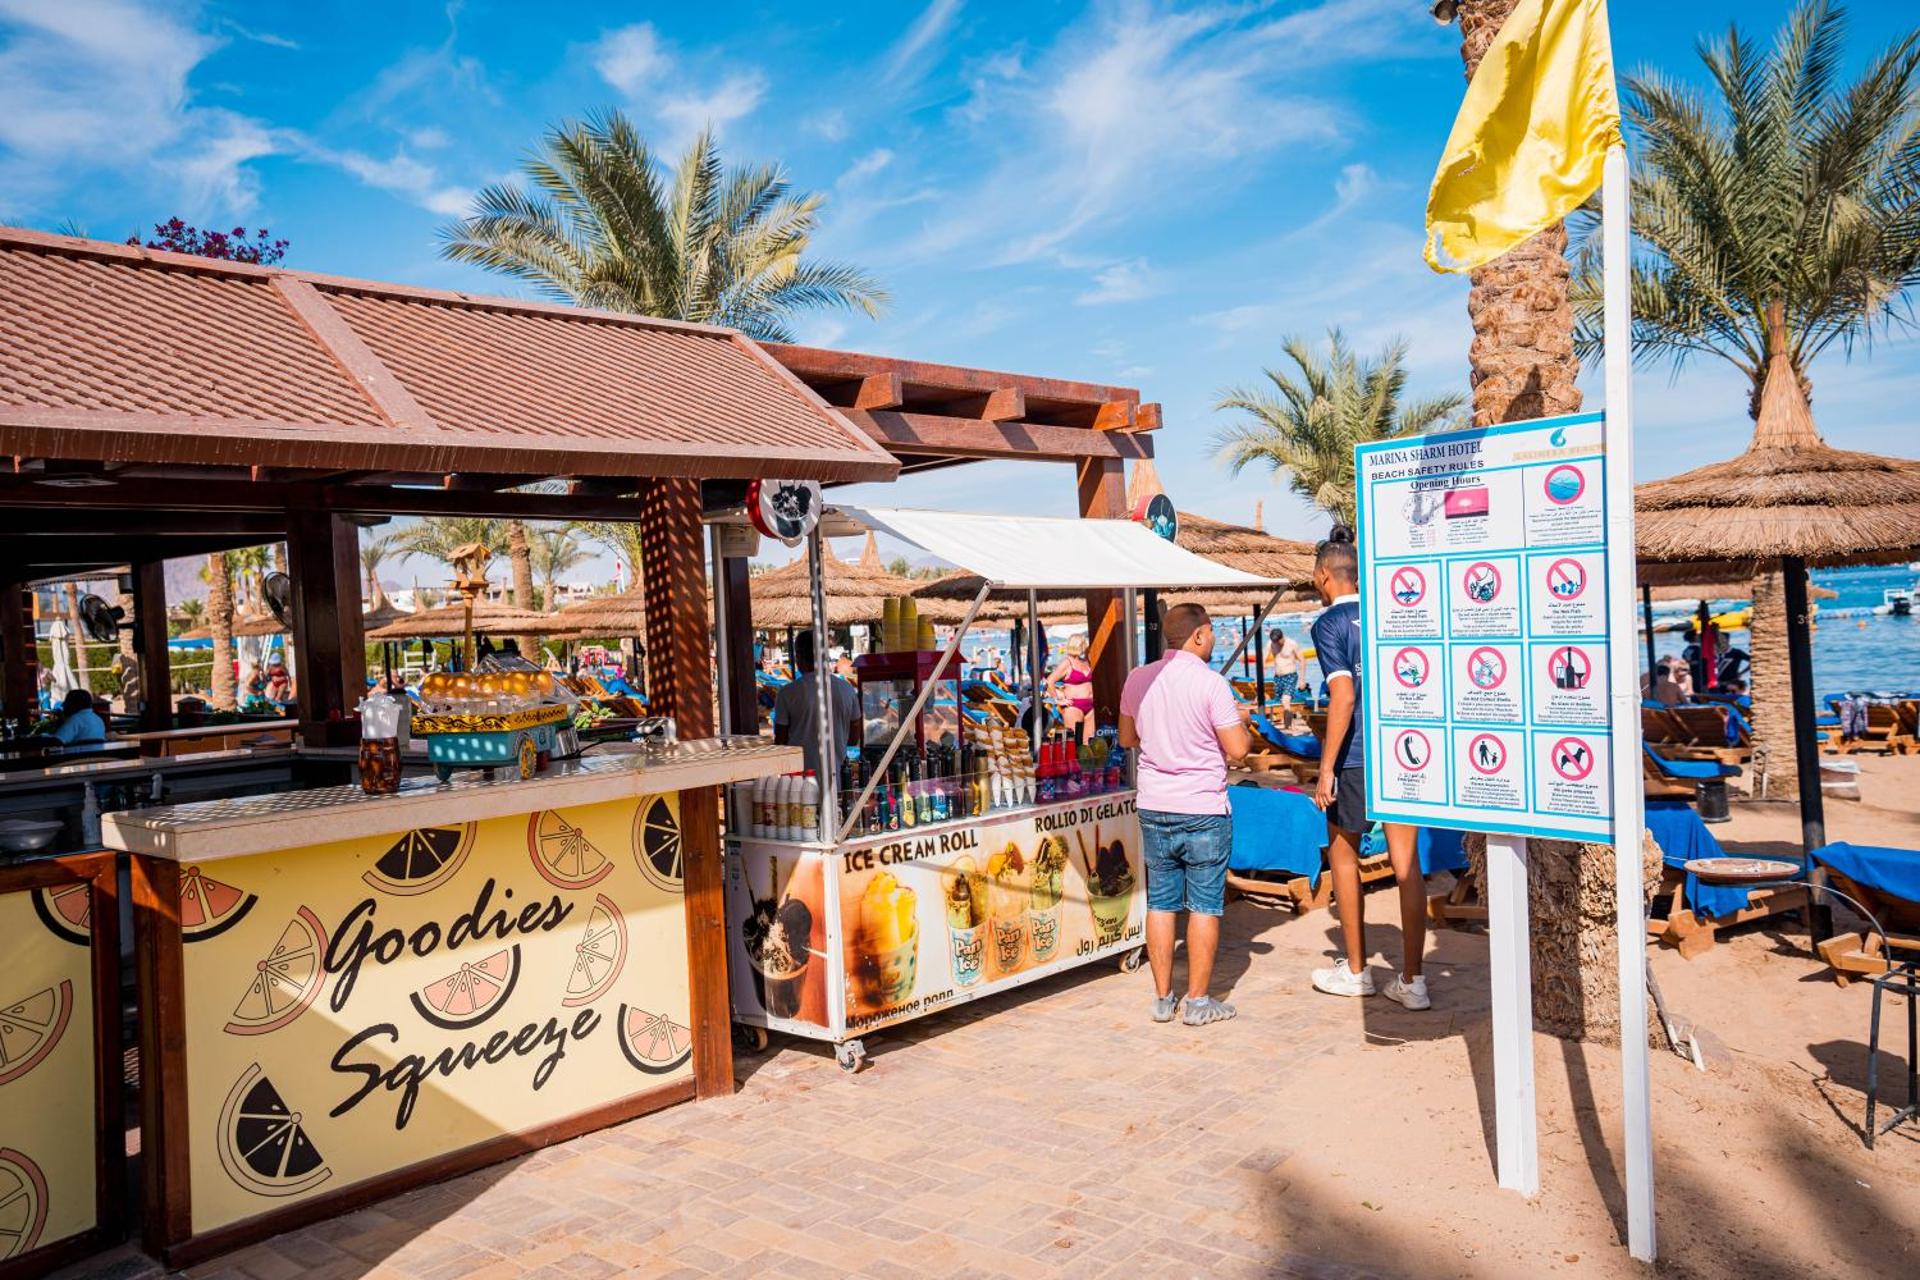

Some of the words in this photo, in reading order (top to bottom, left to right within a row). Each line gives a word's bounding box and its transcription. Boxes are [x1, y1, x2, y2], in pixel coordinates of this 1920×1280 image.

[1369, 451, 1408, 467] MARINA
[1410, 446, 1446, 461] SHARM
[1448, 441, 1483, 457] HOTEL
[1371, 469, 1405, 481] BEACH
[1407, 464, 1447, 477] SAFETY
[1449, 460, 1484, 471] RULES
[1410, 478, 1449, 491] Opening
[1452, 475, 1481, 488] Hours
[1034, 810, 1077, 833] ROLLIO
[1081, 807, 1093, 824] DI
[844, 850, 875, 874] ICE
[879, 838, 935, 865] CREAM
[940, 829, 978, 852] ROLL
[324, 878, 574, 1013] Goodies
[1076, 938, 1094, 957] رول
[329, 1008, 601, 1130] Squeeze
